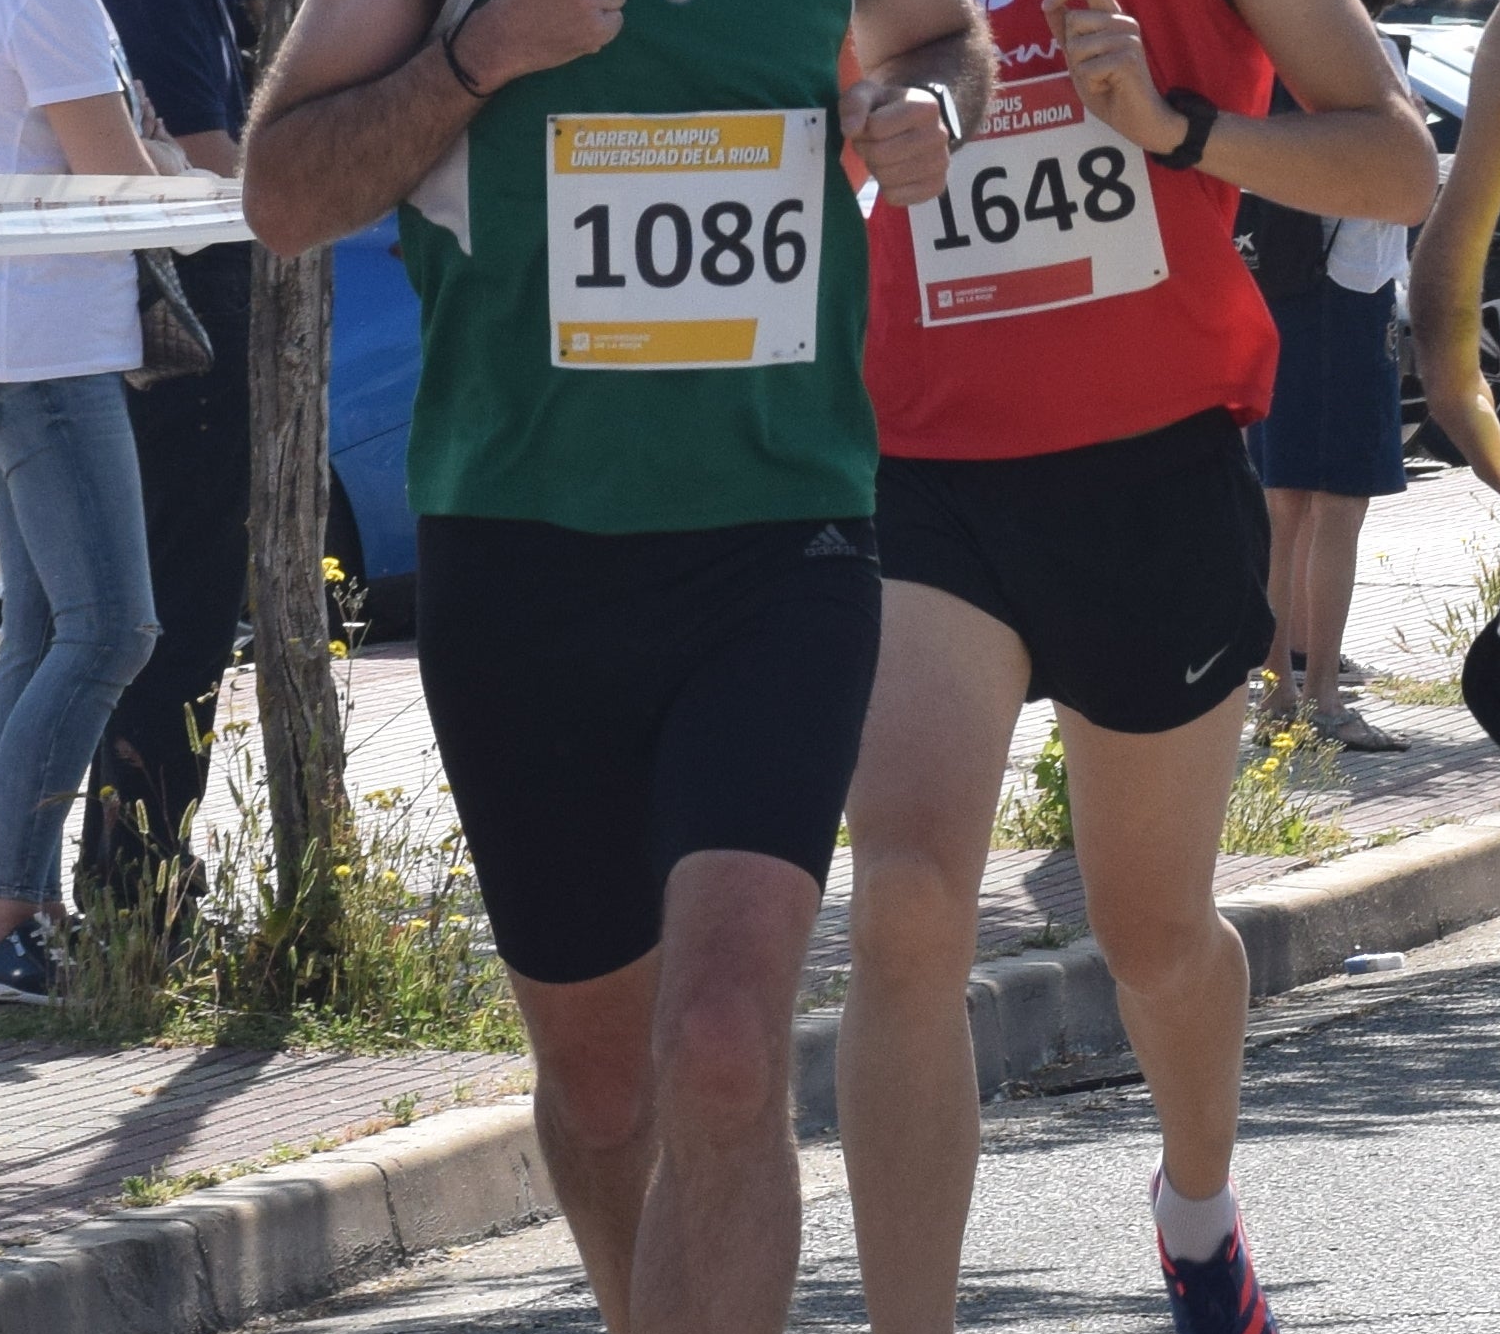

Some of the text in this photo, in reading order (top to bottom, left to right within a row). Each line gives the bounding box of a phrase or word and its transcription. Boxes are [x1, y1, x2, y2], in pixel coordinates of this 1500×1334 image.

[993, 116, 1010, 132] DE
[1013, 112, 1031, 128] LA
[1033, 105, 1073, 125] RIOJA
[574, 129, 720, 148] CARRERA CAMPUS
[571, 146, 770, 167] UNIVERSIDAD DE LA RIOJA
[934, 146, 1135, 250] 1648
[574, 199, 806, 288] 1086
